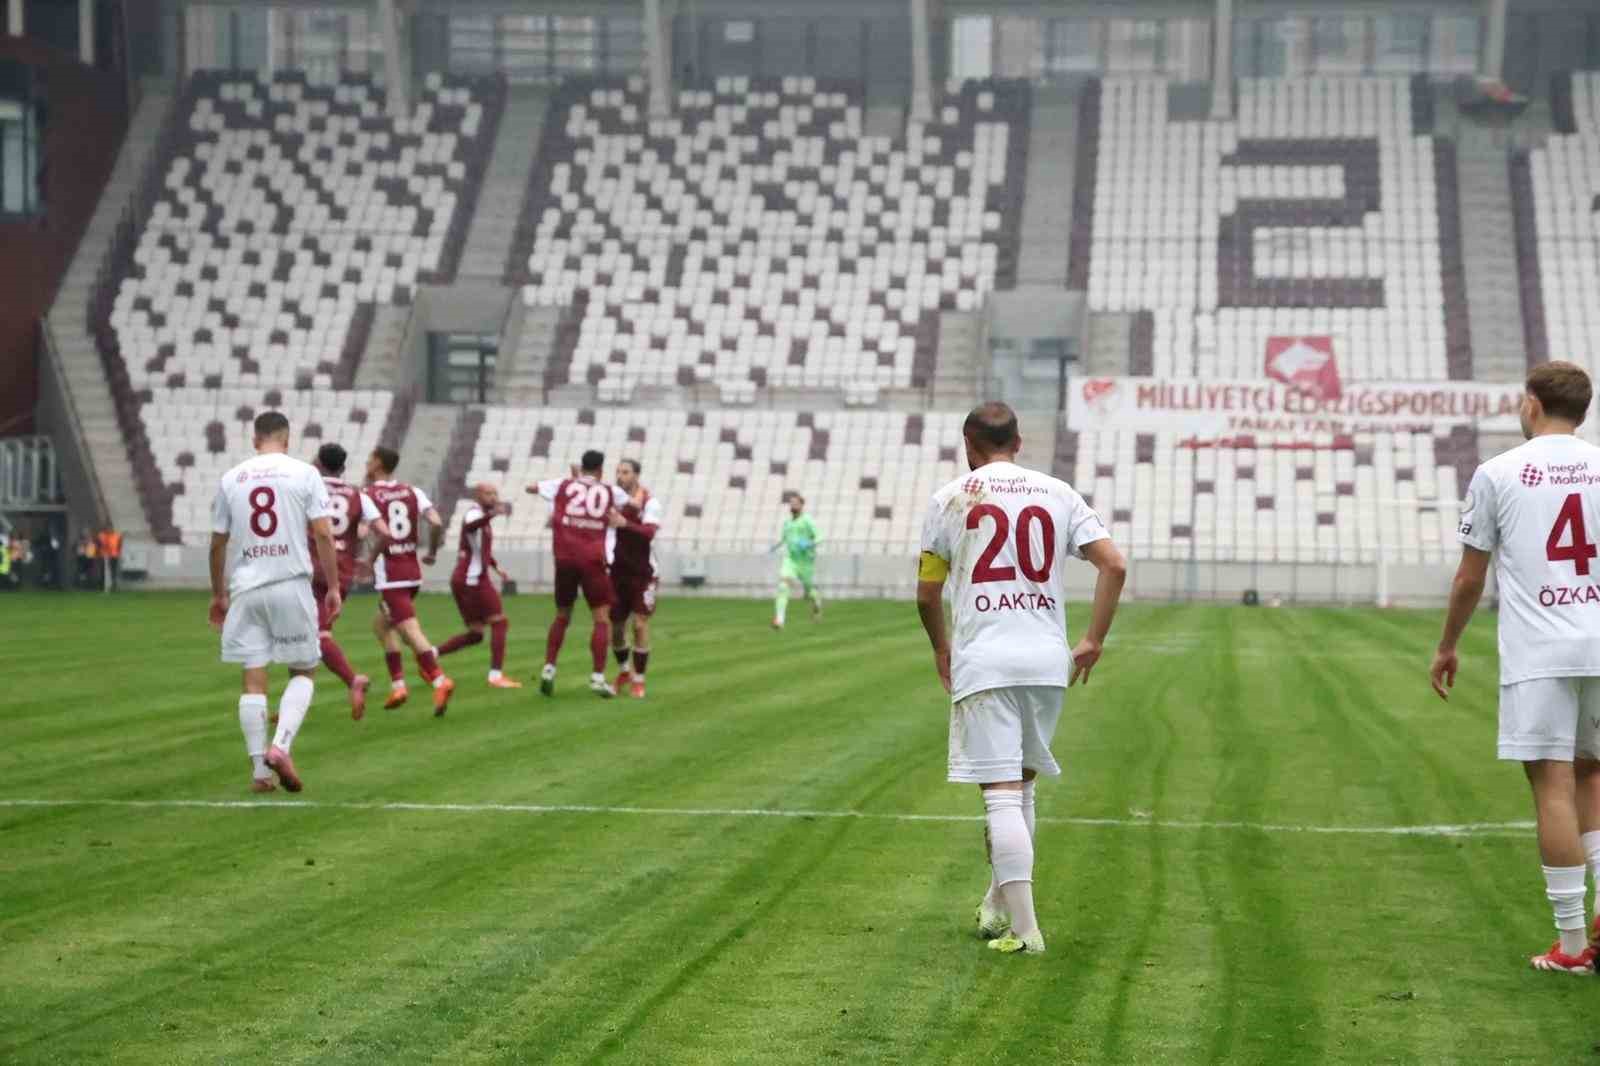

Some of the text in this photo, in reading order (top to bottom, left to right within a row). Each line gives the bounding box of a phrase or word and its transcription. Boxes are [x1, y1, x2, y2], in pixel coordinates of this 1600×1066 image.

[1136, 379, 1276, 414] MİLLİYETÇİ
[249, 486, 278, 538] 8
[388, 500, 412, 540] 8
[565, 482, 609, 518] 20
[242, 543, 290, 560] KEREM
[966, 503, 1056, 585] 20
[1546, 493, 1598, 577] 4
